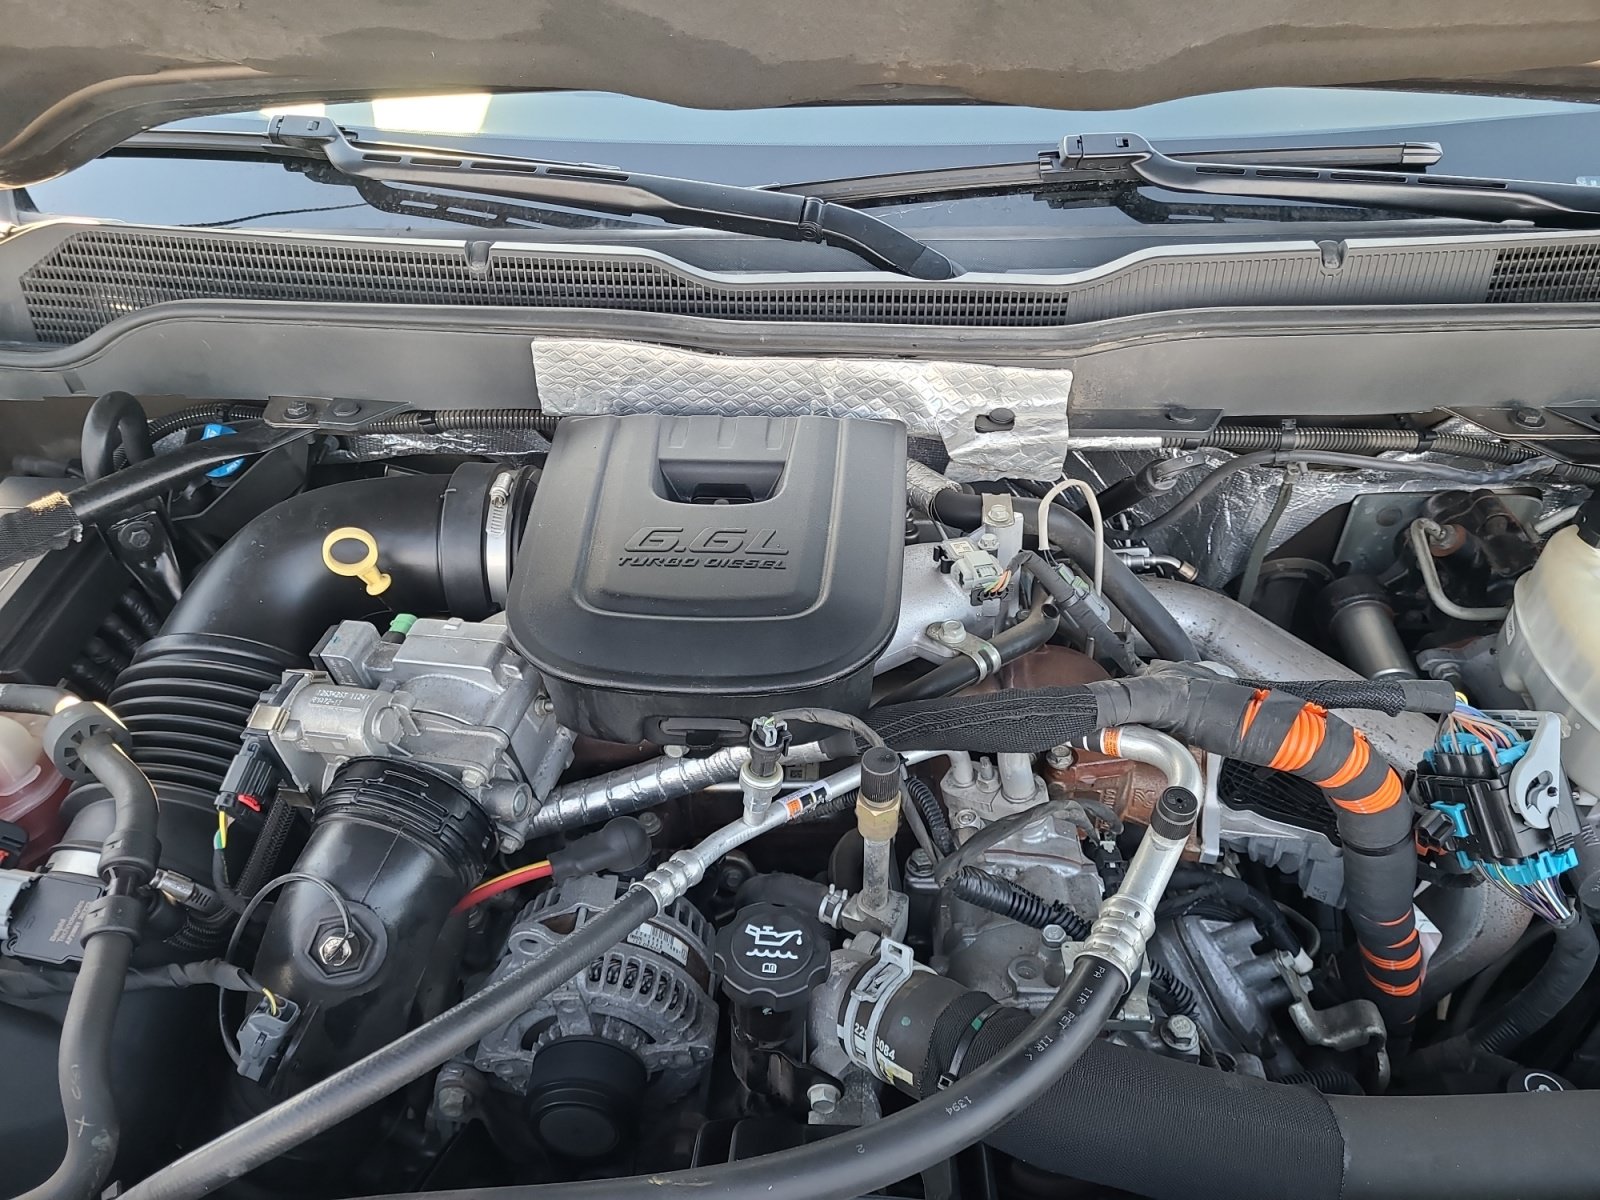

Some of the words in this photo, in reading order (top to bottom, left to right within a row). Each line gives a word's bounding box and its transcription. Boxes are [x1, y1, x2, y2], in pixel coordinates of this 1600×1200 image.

[624, 526, 789, 555] 6.6L
[619, 556, 699, 567] TURBO
[704, 557, 787, 570] DIESEL
[1093, 965, 1106, 979] PA
[1076, 987, 1094, 1005] IIR
[1058, 1010, 1076, 1030] PET
[945, 1095, 972, 1117] 1394
